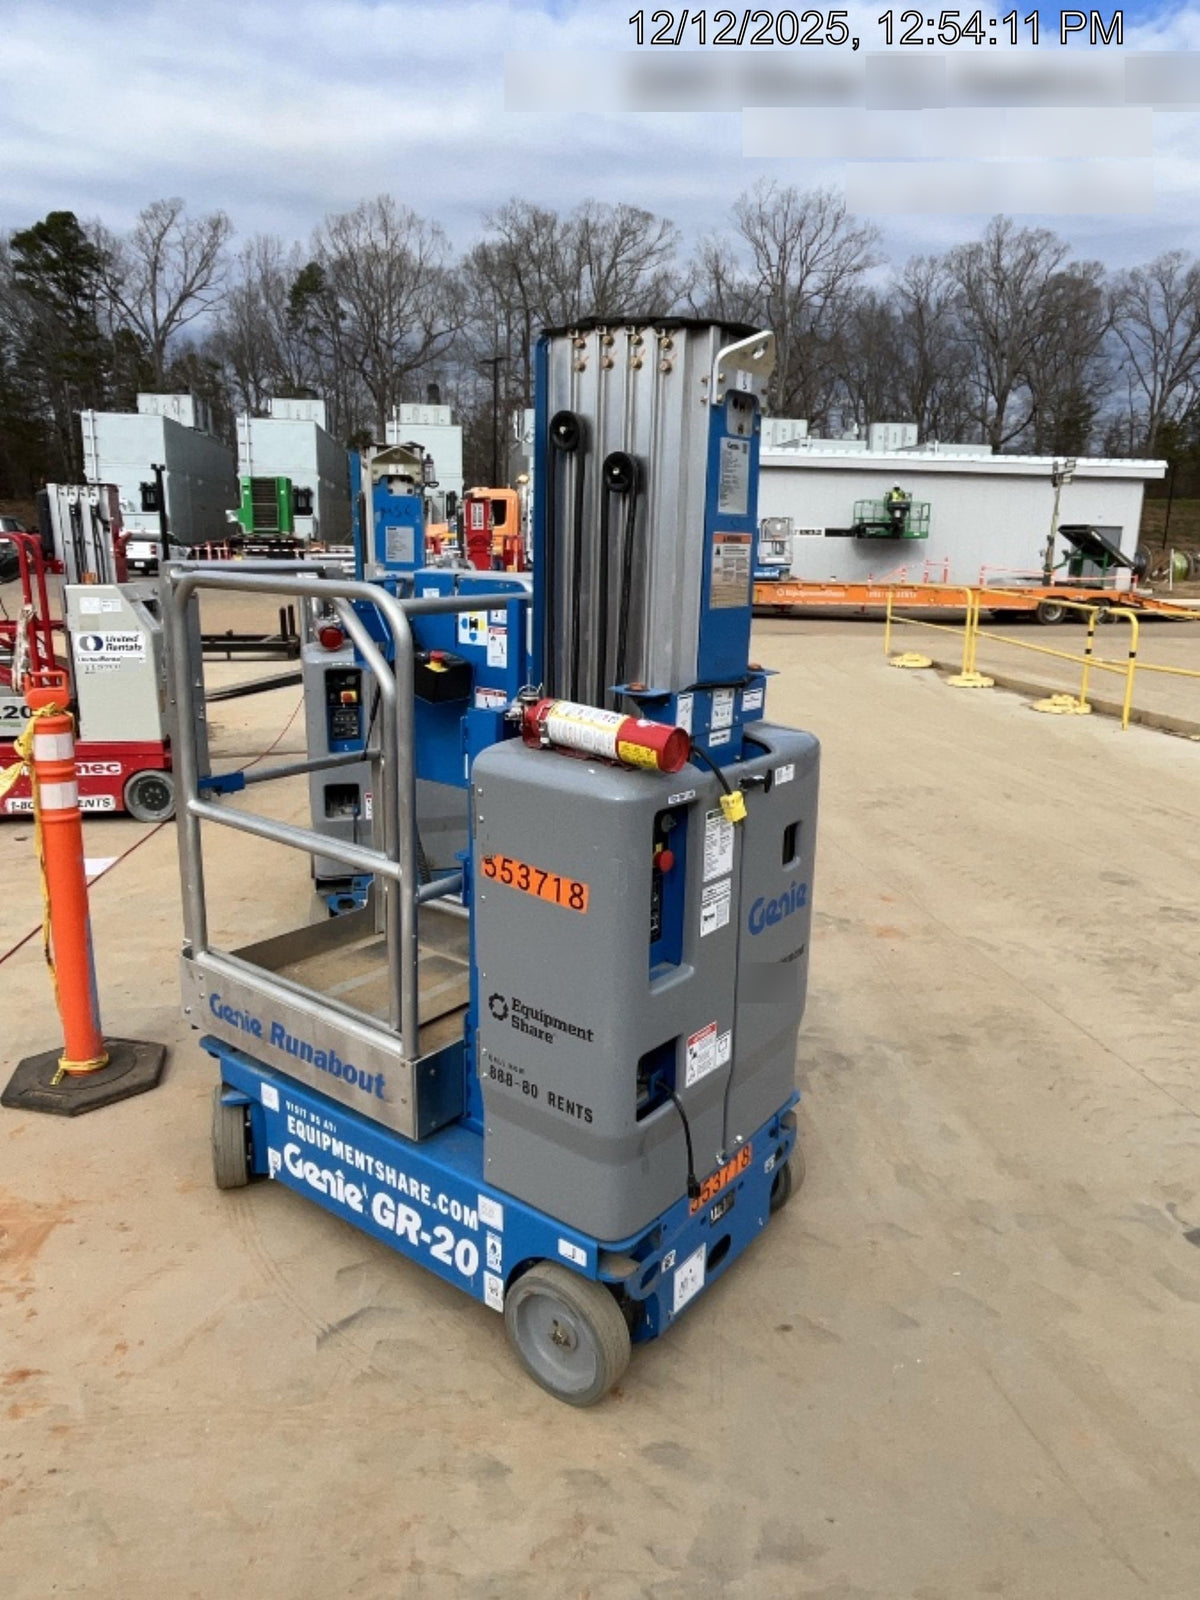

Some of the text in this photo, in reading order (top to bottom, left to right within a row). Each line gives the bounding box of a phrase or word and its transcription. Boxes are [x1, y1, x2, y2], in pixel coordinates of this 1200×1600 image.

[105, 643, 143, 652] Rentals
[483, 857, 584, 911] 553718
[748, 880, 808, 936] Genie
[208, 993, 264, 1039] Genie
[270, 1021, 387, 1099] Runabout
[511, 996, 595, 1042] Equipment
[511, 1014, 554, 1044] Share
[547, 1090, 593, 1124] RENTS
[287, 1114, 480, 1231] EQUIPMENTSHARE.COM
[283, 1142, 365, 1214] Genie
[371, 1192, 480, 1277] GR-20
